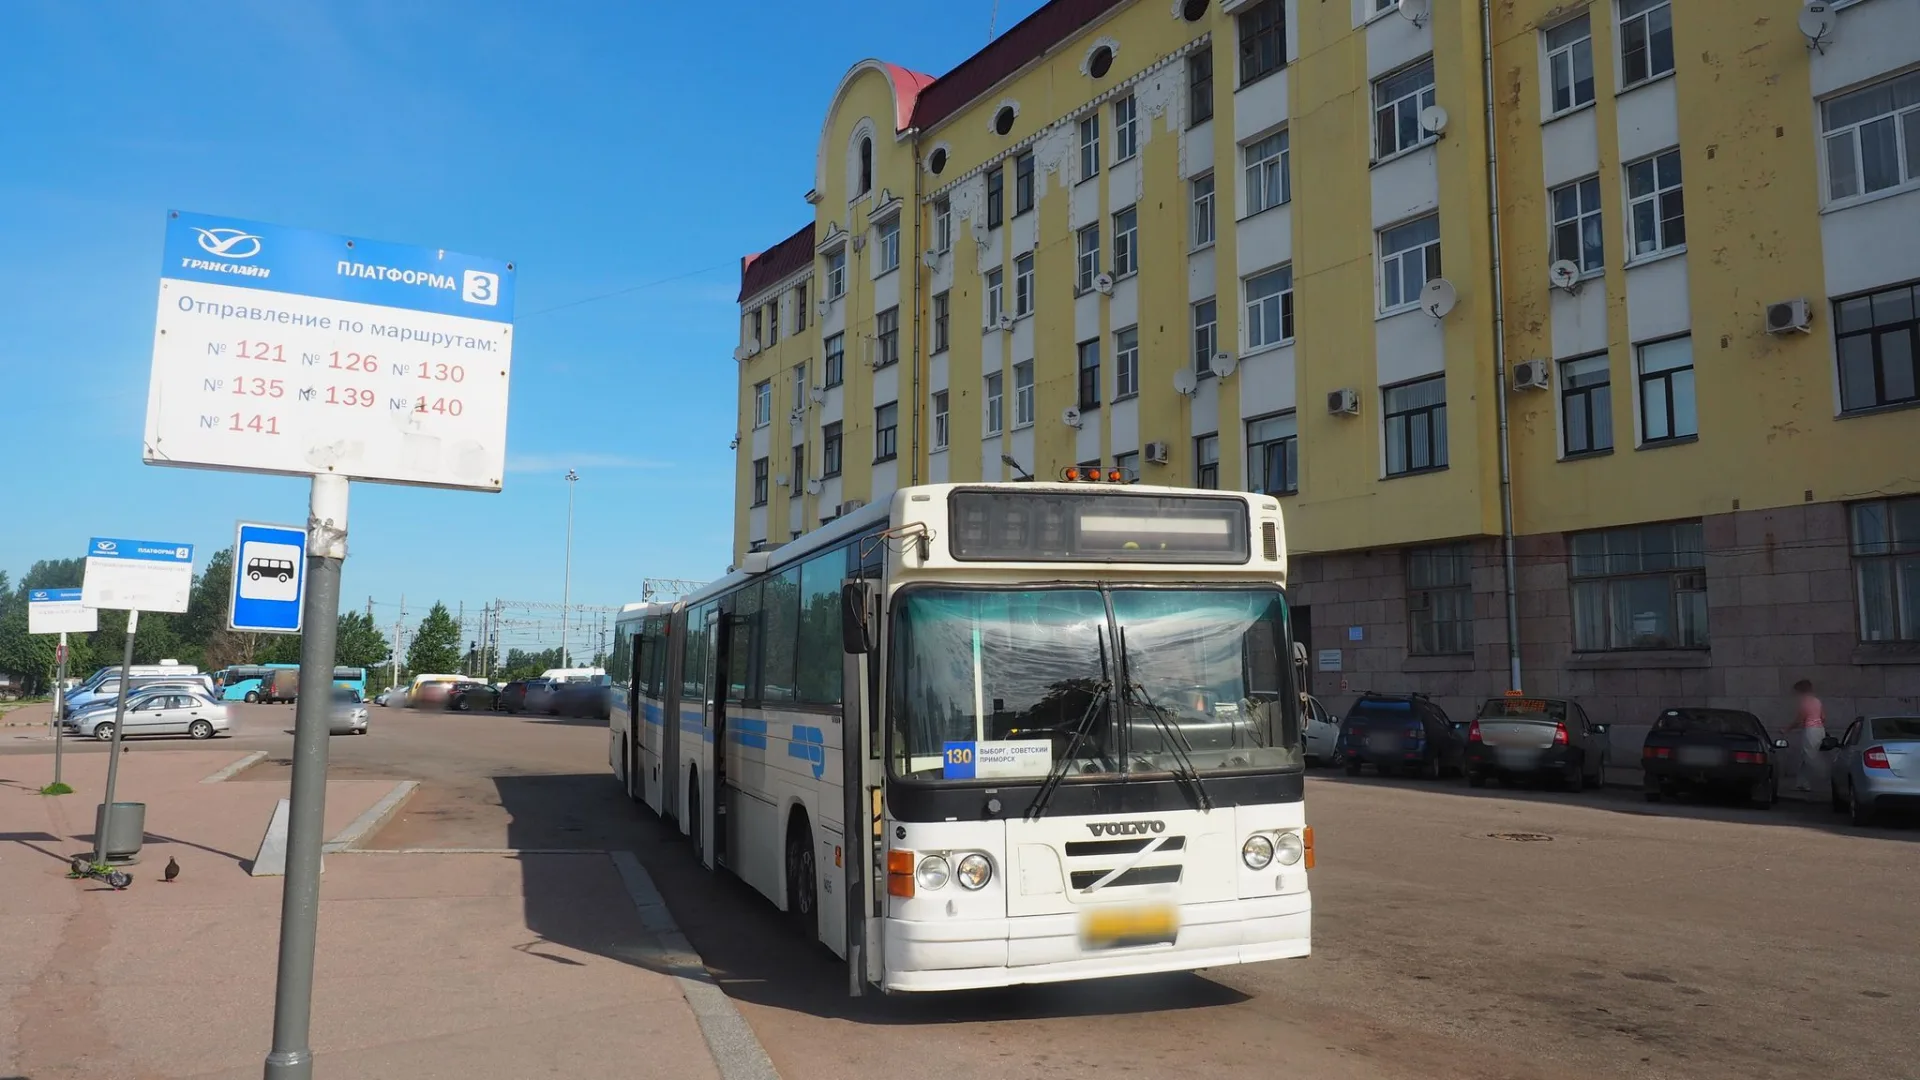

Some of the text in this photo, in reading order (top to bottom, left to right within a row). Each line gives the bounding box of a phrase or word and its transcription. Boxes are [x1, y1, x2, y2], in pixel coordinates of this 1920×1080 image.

[181, 257, 271, 279] ТРАНСЛАЙН
[336, 260, 492, 302] ПЛАТФОРМА 3
[178, 295, 498, 353] Отправление по маршрутам:
[236, 340, 287, 363] 121
[328, 351, 378, 373] 126
[417, 361, 465, 383] 130
[232, 376, 285, 398] 135
[325, 386, 375, 408] 139
[414, 395, 463, 417] 140
[228, 412, 281, 435] 141
[137, 547, 175, 556] ПЛАТФОРМА
[945, 748, 973, 765] 130
[979, 755, 1016, 764] ПРИМОРСК
[1085, 819, 1166, 837] VOLVO
